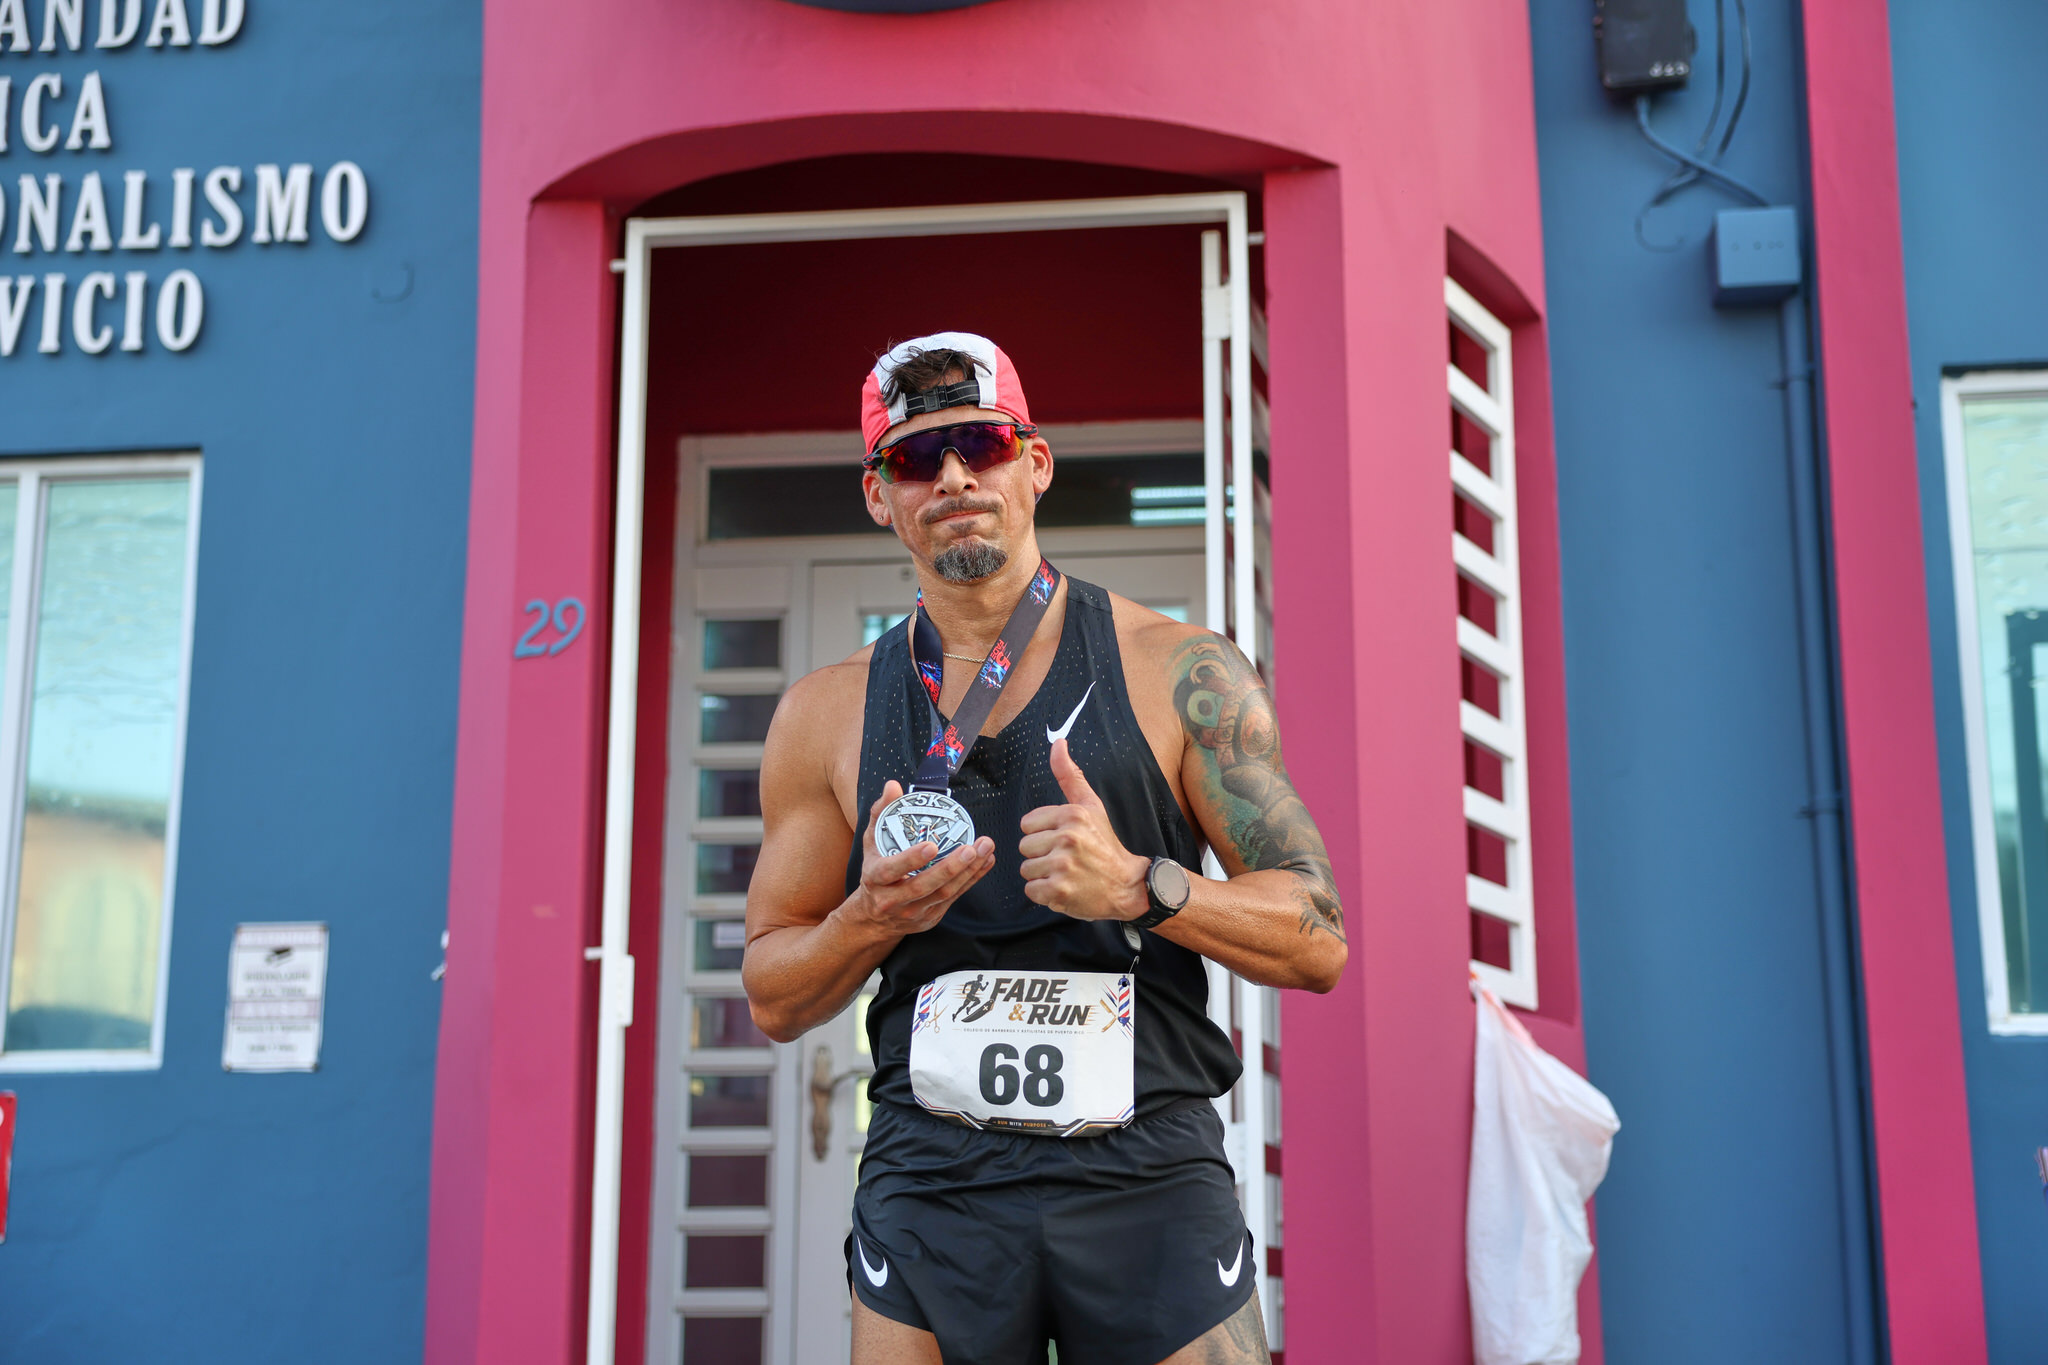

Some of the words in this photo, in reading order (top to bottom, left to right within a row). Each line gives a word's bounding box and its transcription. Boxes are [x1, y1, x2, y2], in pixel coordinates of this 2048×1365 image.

[0, 160, 368, 253] NALISMO
[514, 597, 586, 659] 29
[990, 639, 1005, 660] FADE
[991, 651, 1012, 683] 5K
[945, 736, 965, 765] 5K
[915, 793, 943, 807] 5K
[989, 977, 1070, 1003] FADE
[1008, 1003, 1026, 1022] &
[1027, 1003, 1091, 1026] RUN
[979, 1043, 1065, 1107] 68
